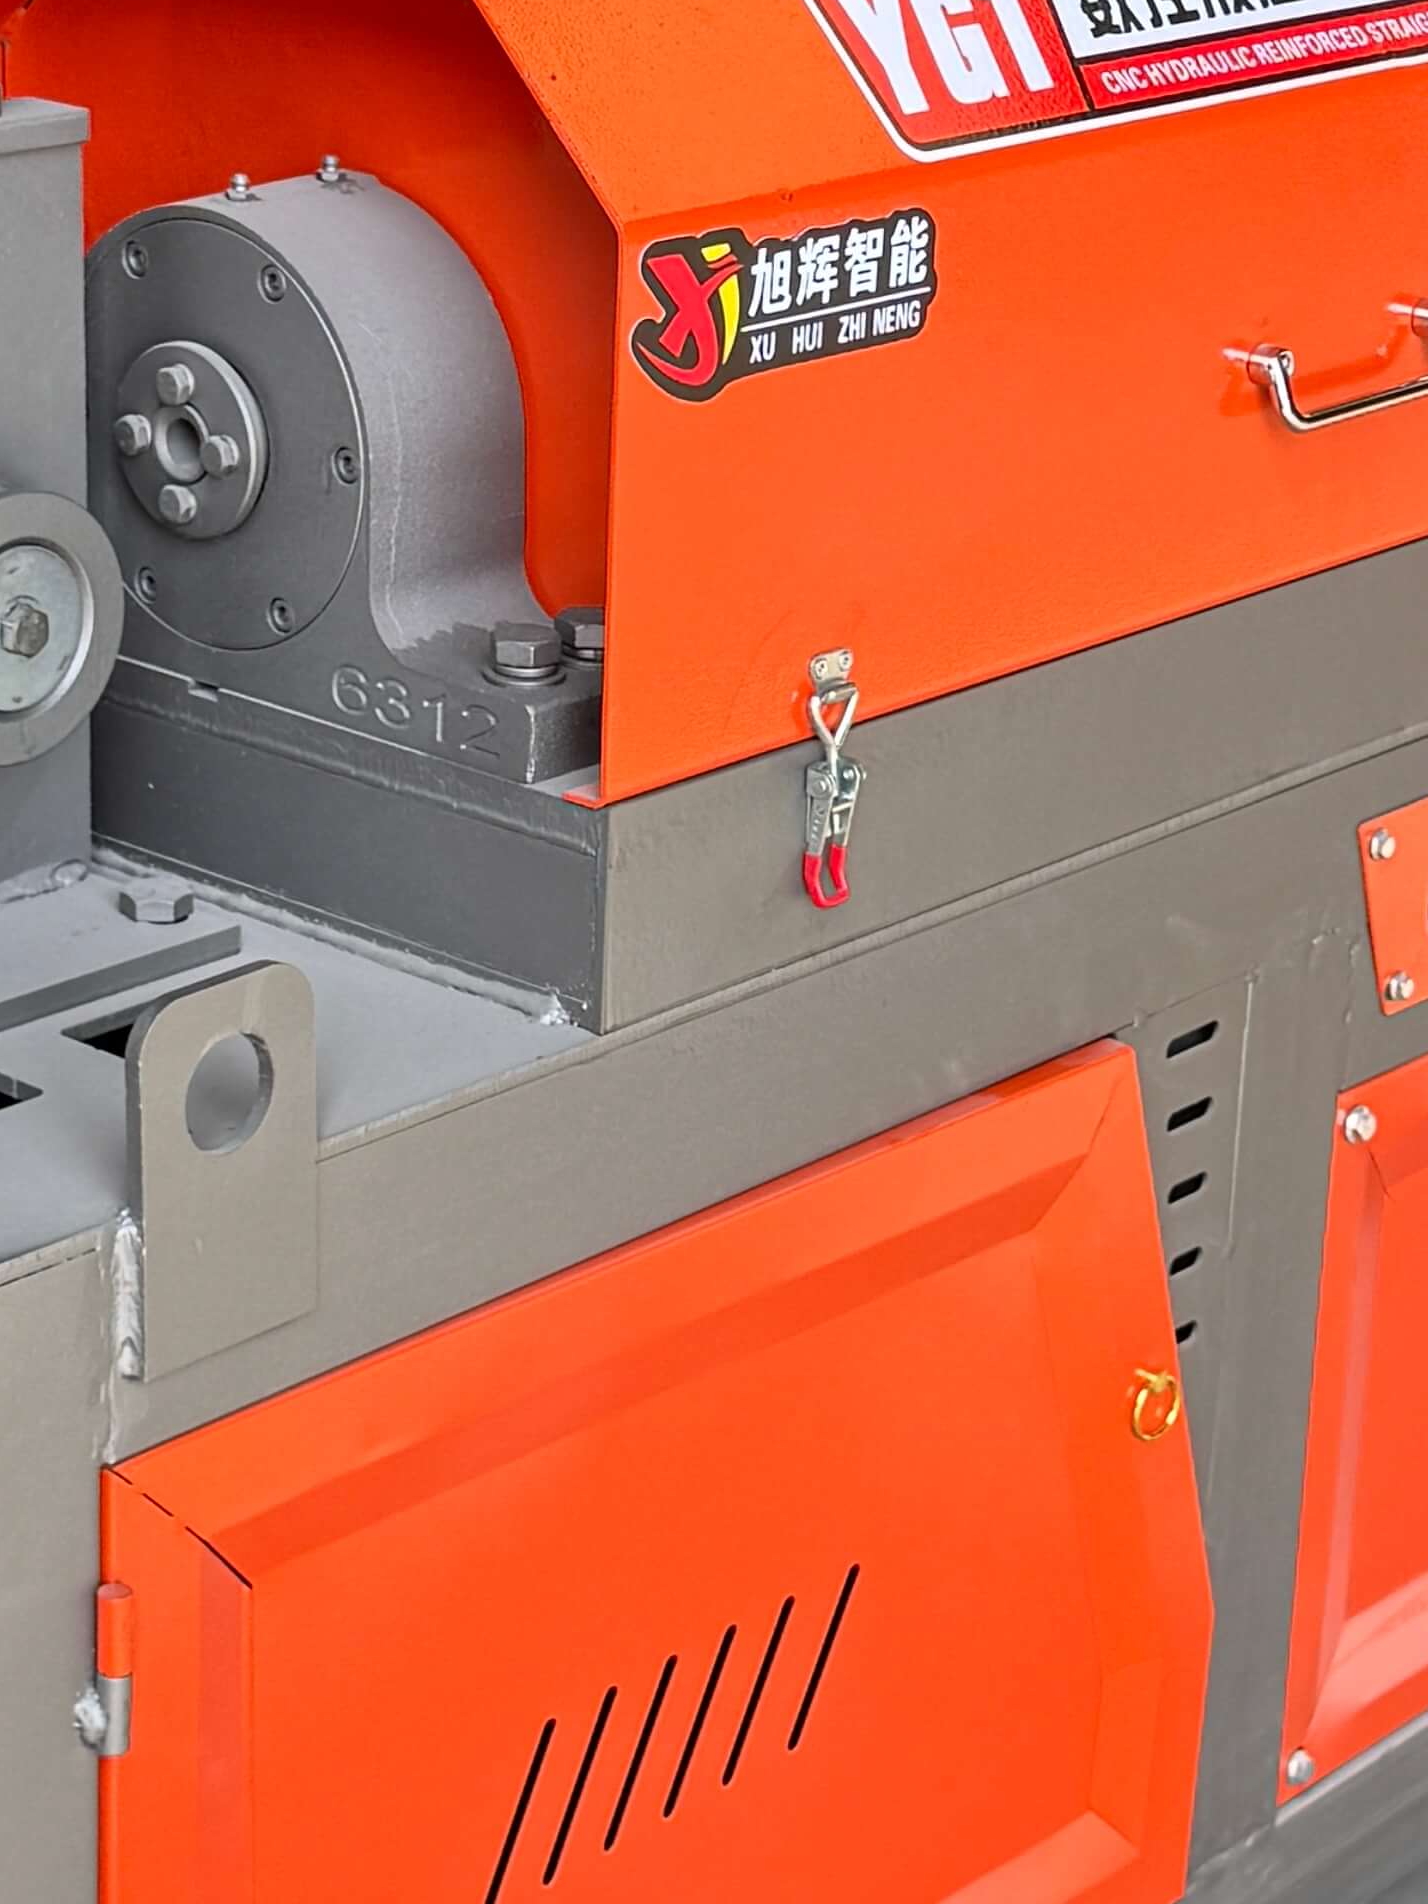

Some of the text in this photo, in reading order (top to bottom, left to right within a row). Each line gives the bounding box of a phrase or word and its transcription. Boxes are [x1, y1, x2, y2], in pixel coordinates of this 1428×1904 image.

[1100, 68, 1149, 95] CNC
[1145, 47, 1258, 87] HYDRAULIC
[1255, 25, 1369, 67] REINFORCED
[747, 215, 930, 318] 旭辉智能
[749, 299, 922, 365] XU HUI ZHI NENG
[331, 663, 502, 761] 6312
